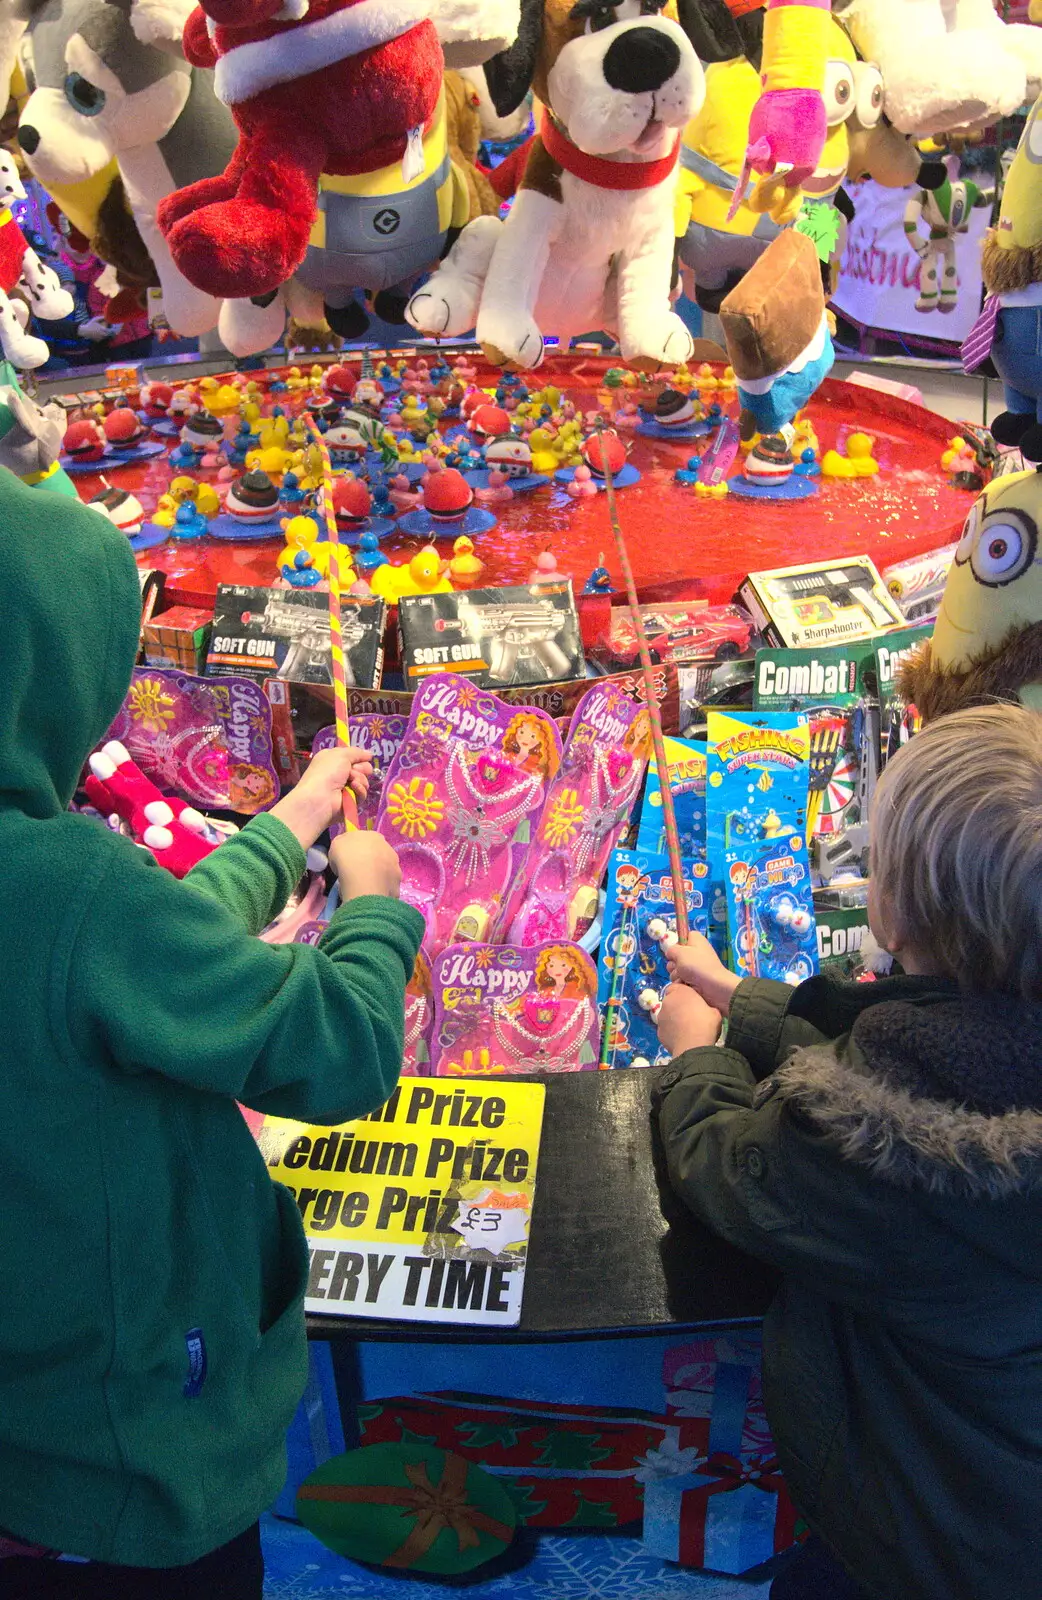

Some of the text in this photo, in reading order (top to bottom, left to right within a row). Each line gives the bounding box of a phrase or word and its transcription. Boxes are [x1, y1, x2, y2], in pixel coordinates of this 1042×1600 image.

[213, 636, 276, 657] SOFT GUN
[804, 620, 863, 640] Sharpshooter
[413, 643, 482, 665] SOFT GUN
[758, 660, 849, 695] Combat
[229, 684, 260, 763] Happy
[420, 682, 504, 746] Happy
[582, 693, 629, 742] Happy
[714, 729, 807, 763] FISHING
[727, 752, 761, 775] SUPER
[439, 954, 533, 994] Happy
[406, 1086, 506, 1129] Prize
[269, 1131, 529, 1183] edium Prize
[402, 1256, 513, 1313] TIME
